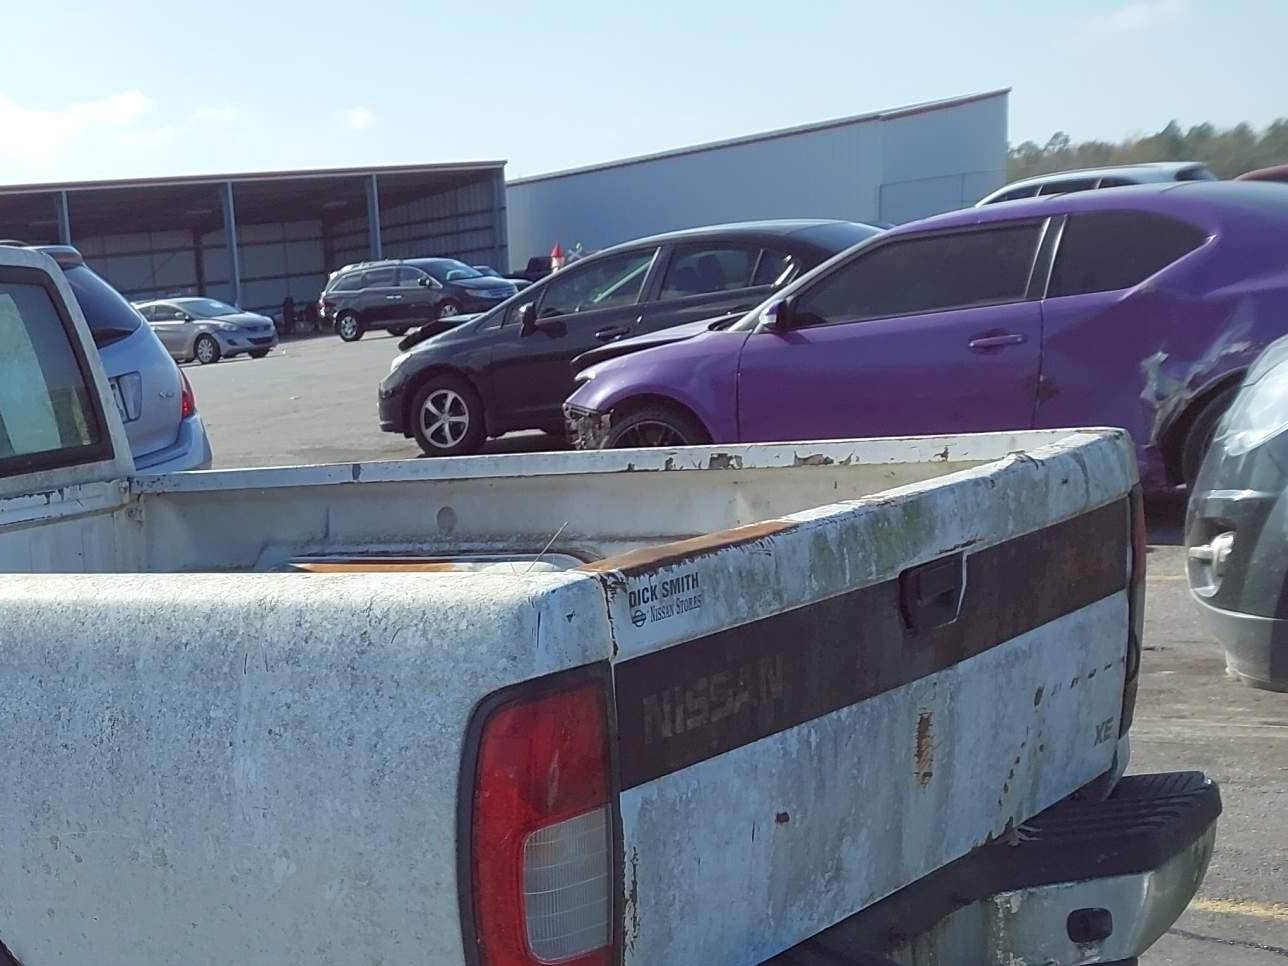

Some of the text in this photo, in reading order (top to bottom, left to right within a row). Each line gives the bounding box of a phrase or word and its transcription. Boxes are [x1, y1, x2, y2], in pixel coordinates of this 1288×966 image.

[628, 572, 700, 609] DICK SMITH
[643, 653, 785, 745] NISSAN
[1092, 716, 1114, 748] XE
